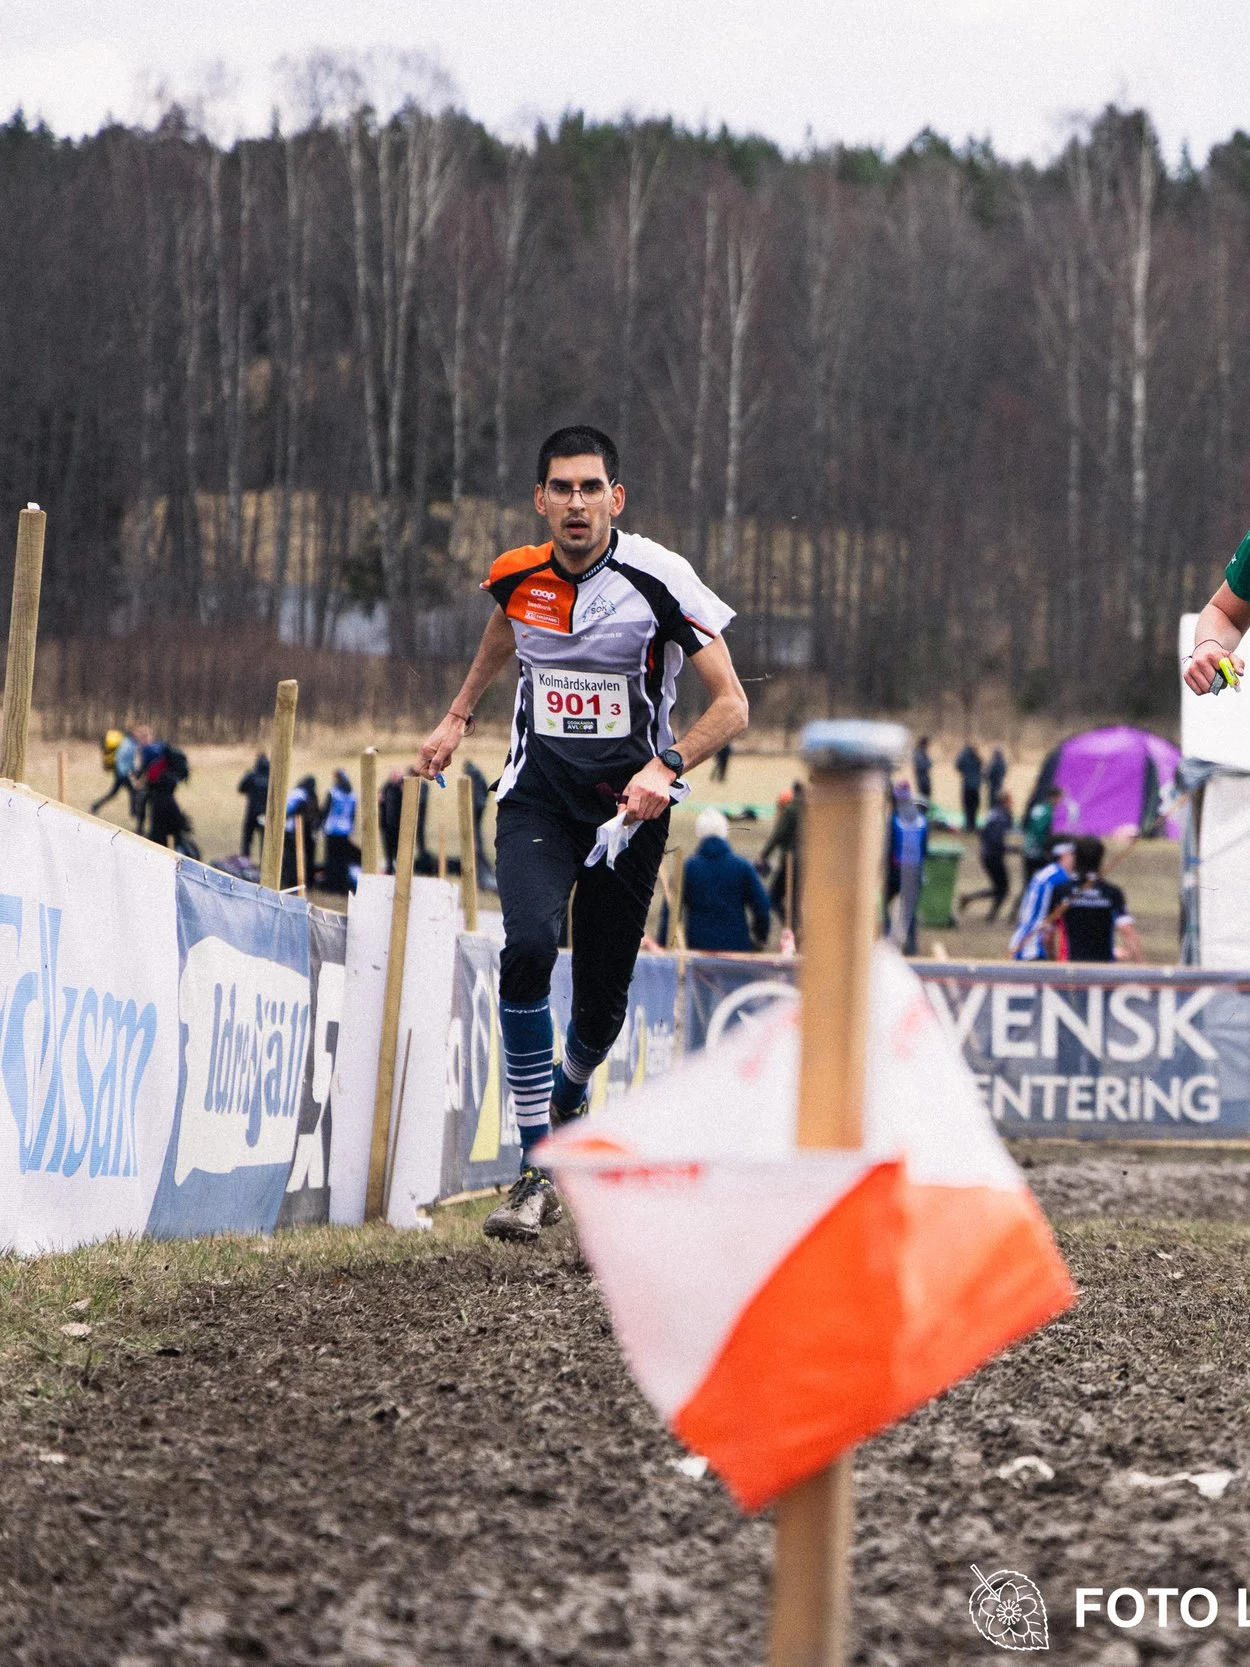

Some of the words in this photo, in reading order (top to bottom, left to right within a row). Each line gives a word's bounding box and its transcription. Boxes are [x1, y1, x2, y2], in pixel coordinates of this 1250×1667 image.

[530, 588, 557, 600] coop
[538, 673, 620, 691] Kolmårdskavlen
[546, 690, 601, 716] 901
[610, 703, 621, 716] 3
[924, 981, 1218, 1062] VENSK
